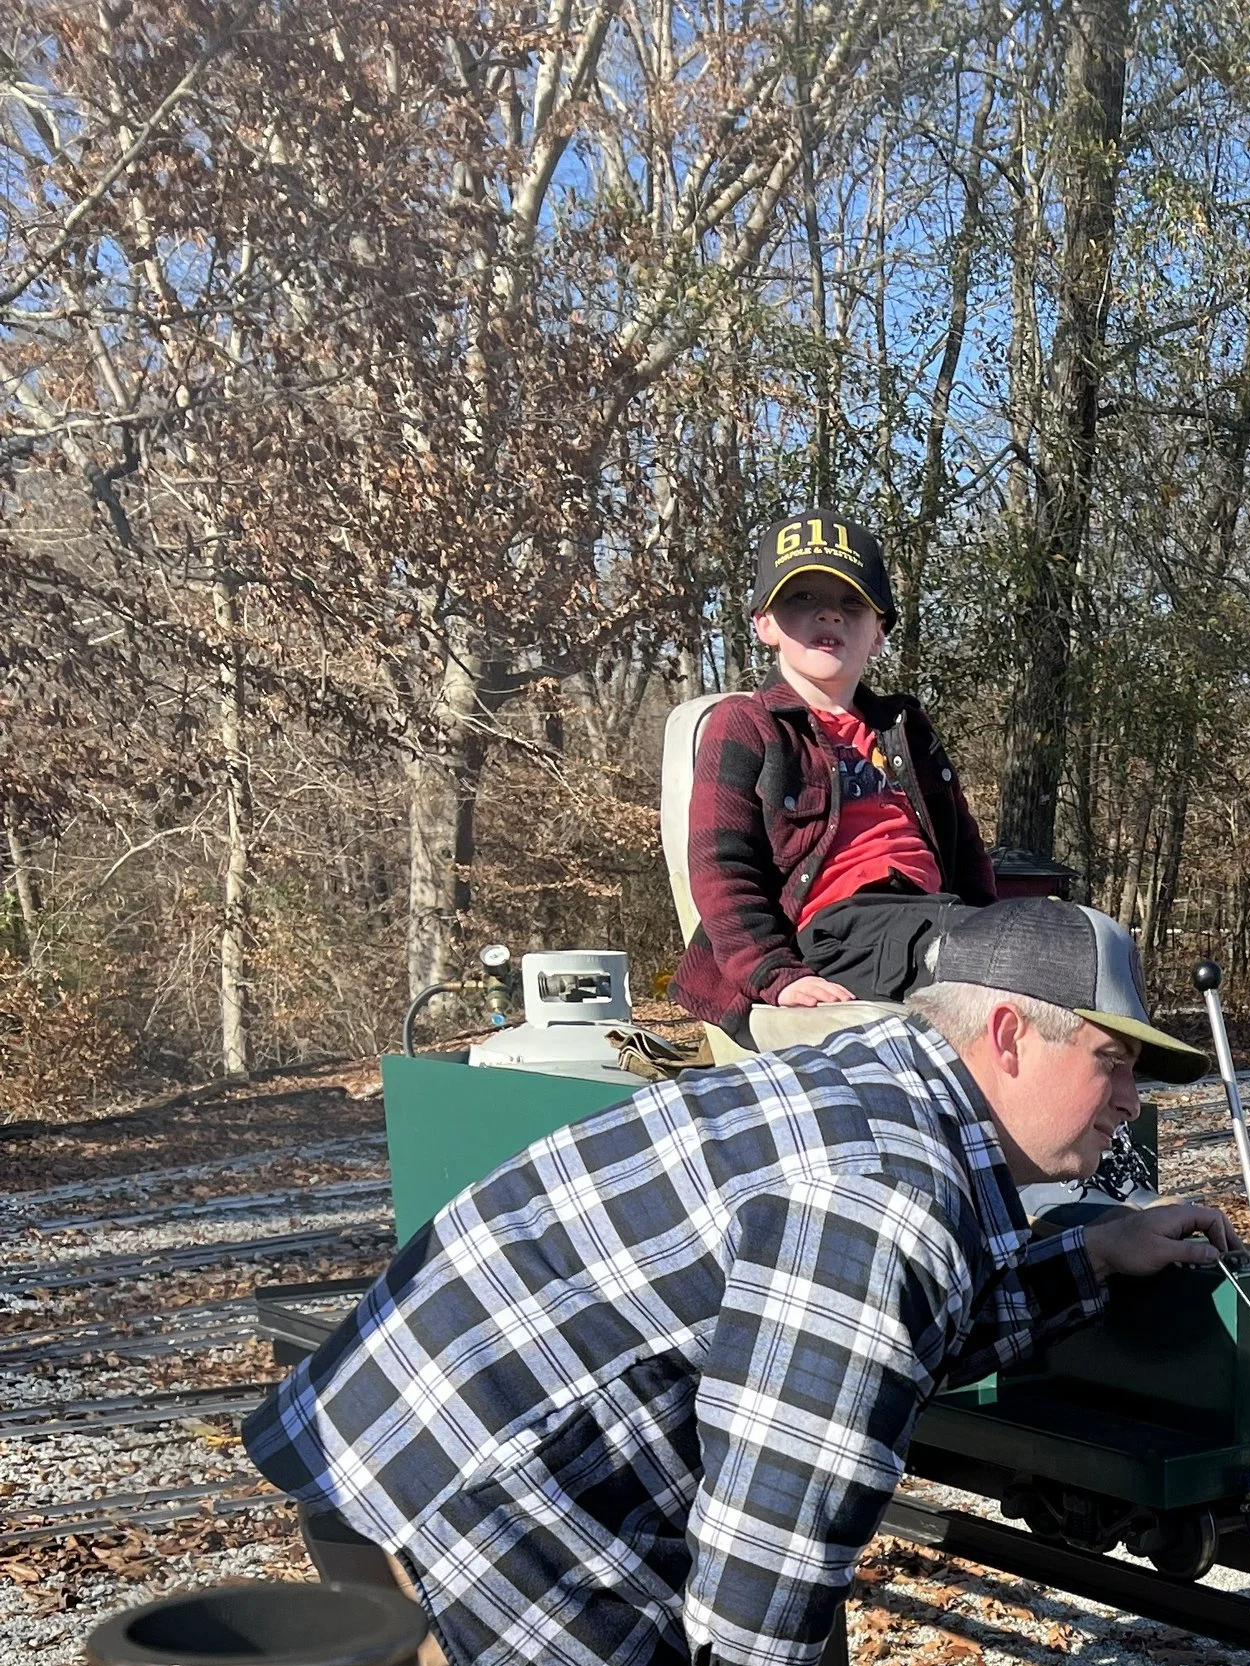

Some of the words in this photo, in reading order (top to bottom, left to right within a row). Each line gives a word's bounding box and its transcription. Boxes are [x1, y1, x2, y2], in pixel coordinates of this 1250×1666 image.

[776, 519, 852, 555] 611
[774, 547, 812, 568] NORFOLK
[813, 546, 823, 554] &
[824, 546, 864, 568] WESTERN
